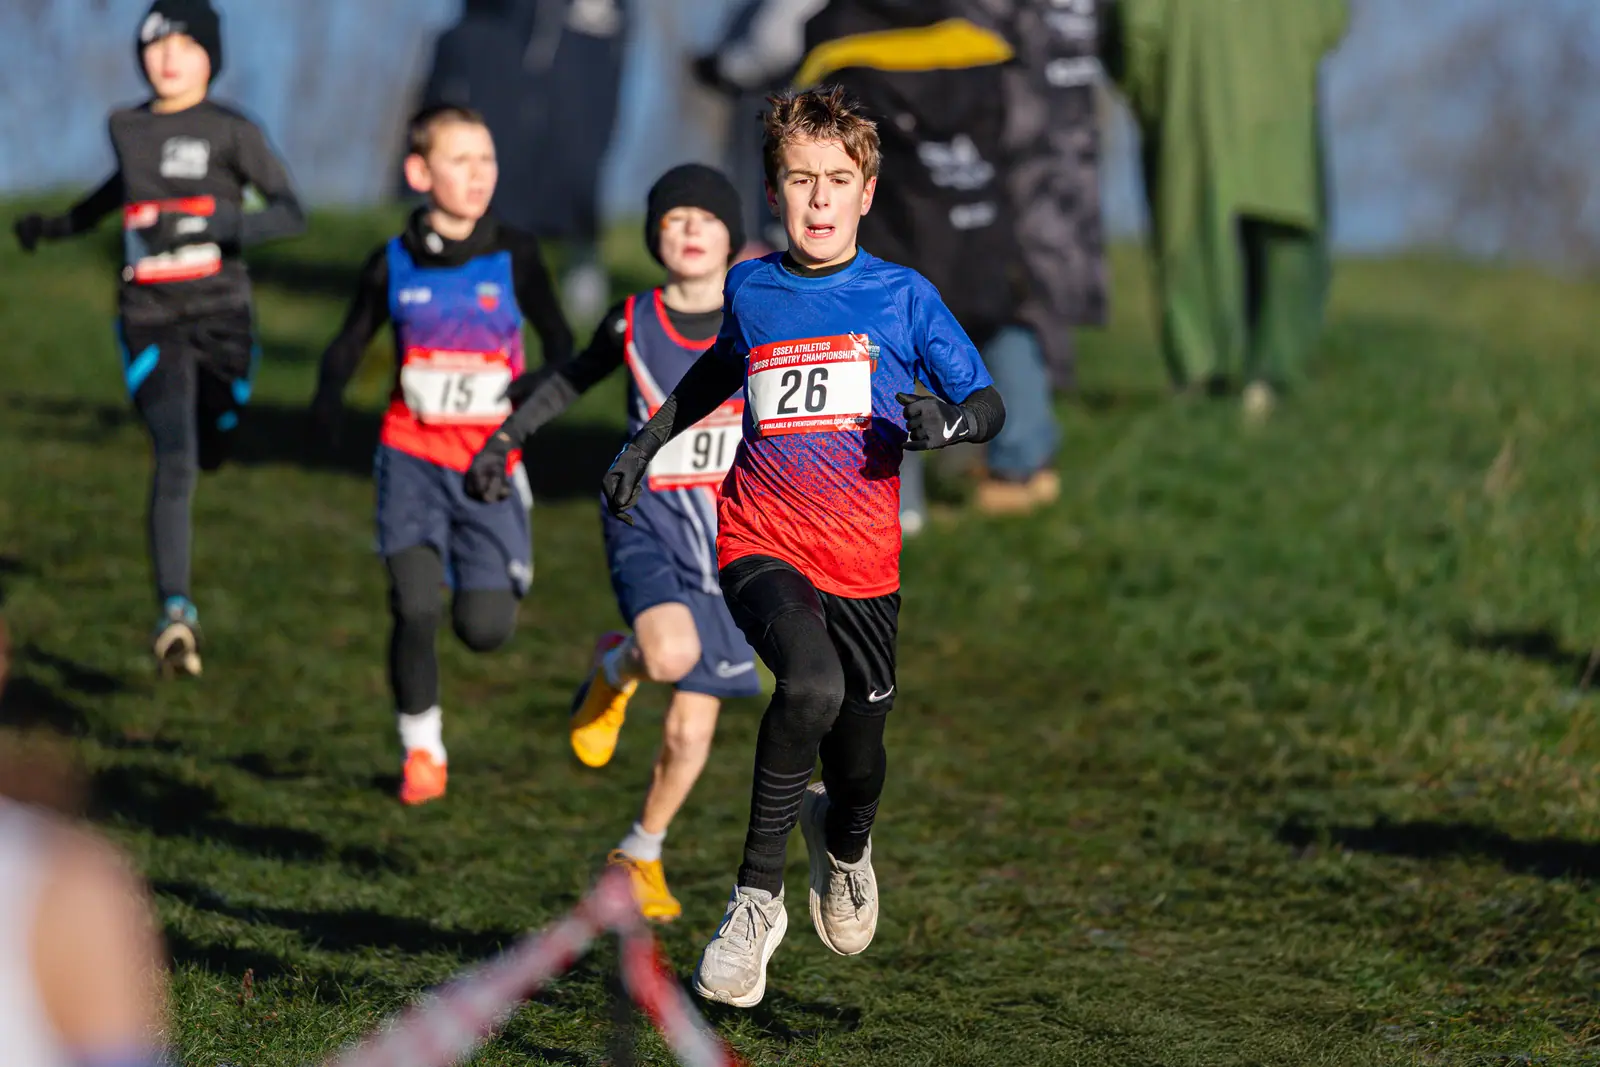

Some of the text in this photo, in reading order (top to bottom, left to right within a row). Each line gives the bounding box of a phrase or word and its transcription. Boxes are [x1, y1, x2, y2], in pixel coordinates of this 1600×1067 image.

[751, 358, 769, 372] CROSS
[769, 354, 800, 367] COUNTRY
[772, 341, 831, 357] ESSEX ATHLETICS
[441, 373, 475, 412] 15
[777, 367, 829, 415] 26
[764, 421, 787, 430] AVAILABLE
[692, 430, 726, 470] 91
